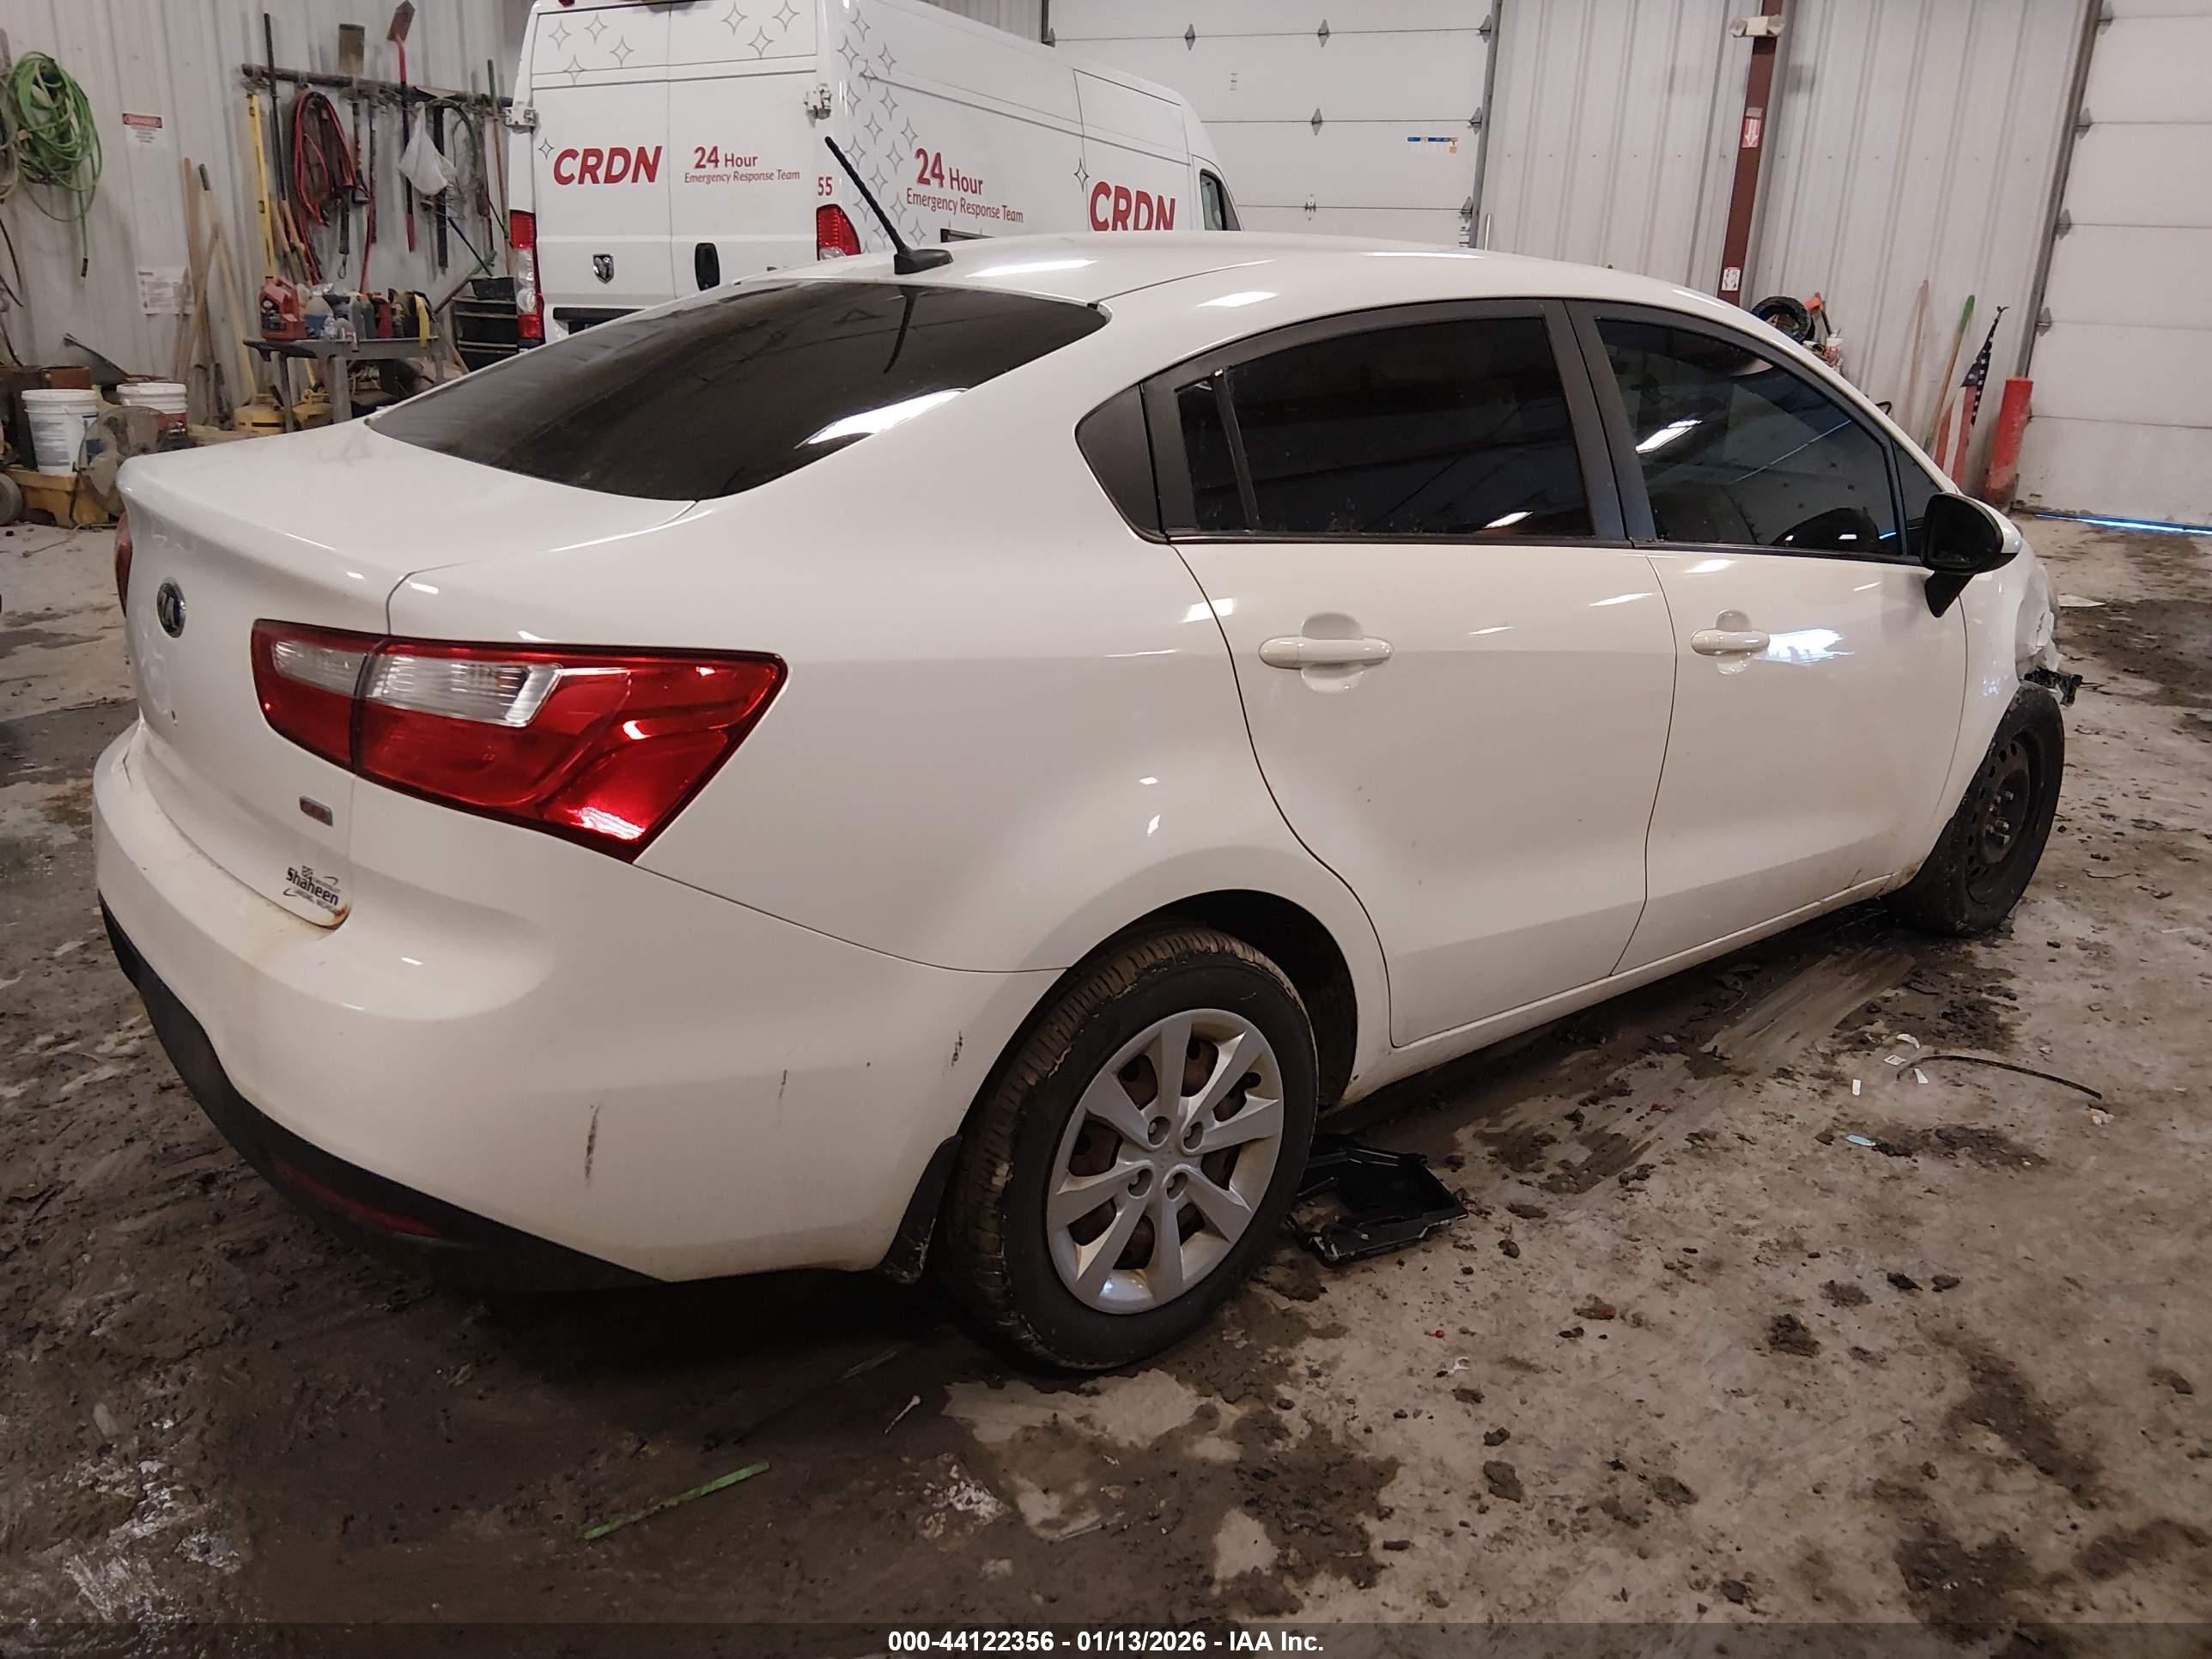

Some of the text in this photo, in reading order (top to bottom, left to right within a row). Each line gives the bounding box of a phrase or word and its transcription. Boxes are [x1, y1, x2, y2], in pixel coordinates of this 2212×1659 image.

[553, 145, 662, 185] CRDN
[694, 145, 758, 169] 24 Hour
[915, 148, 983, 196] 24 Hour
[684, 168, 800, 185] Emergency Response Team
[817, 176, 833, 197] 55
[907, 187, 1024, 223] Emergency Response Team
[1090, 180, 1176, 232] CRDN
[285, 866, 339, 907] Shaheen
